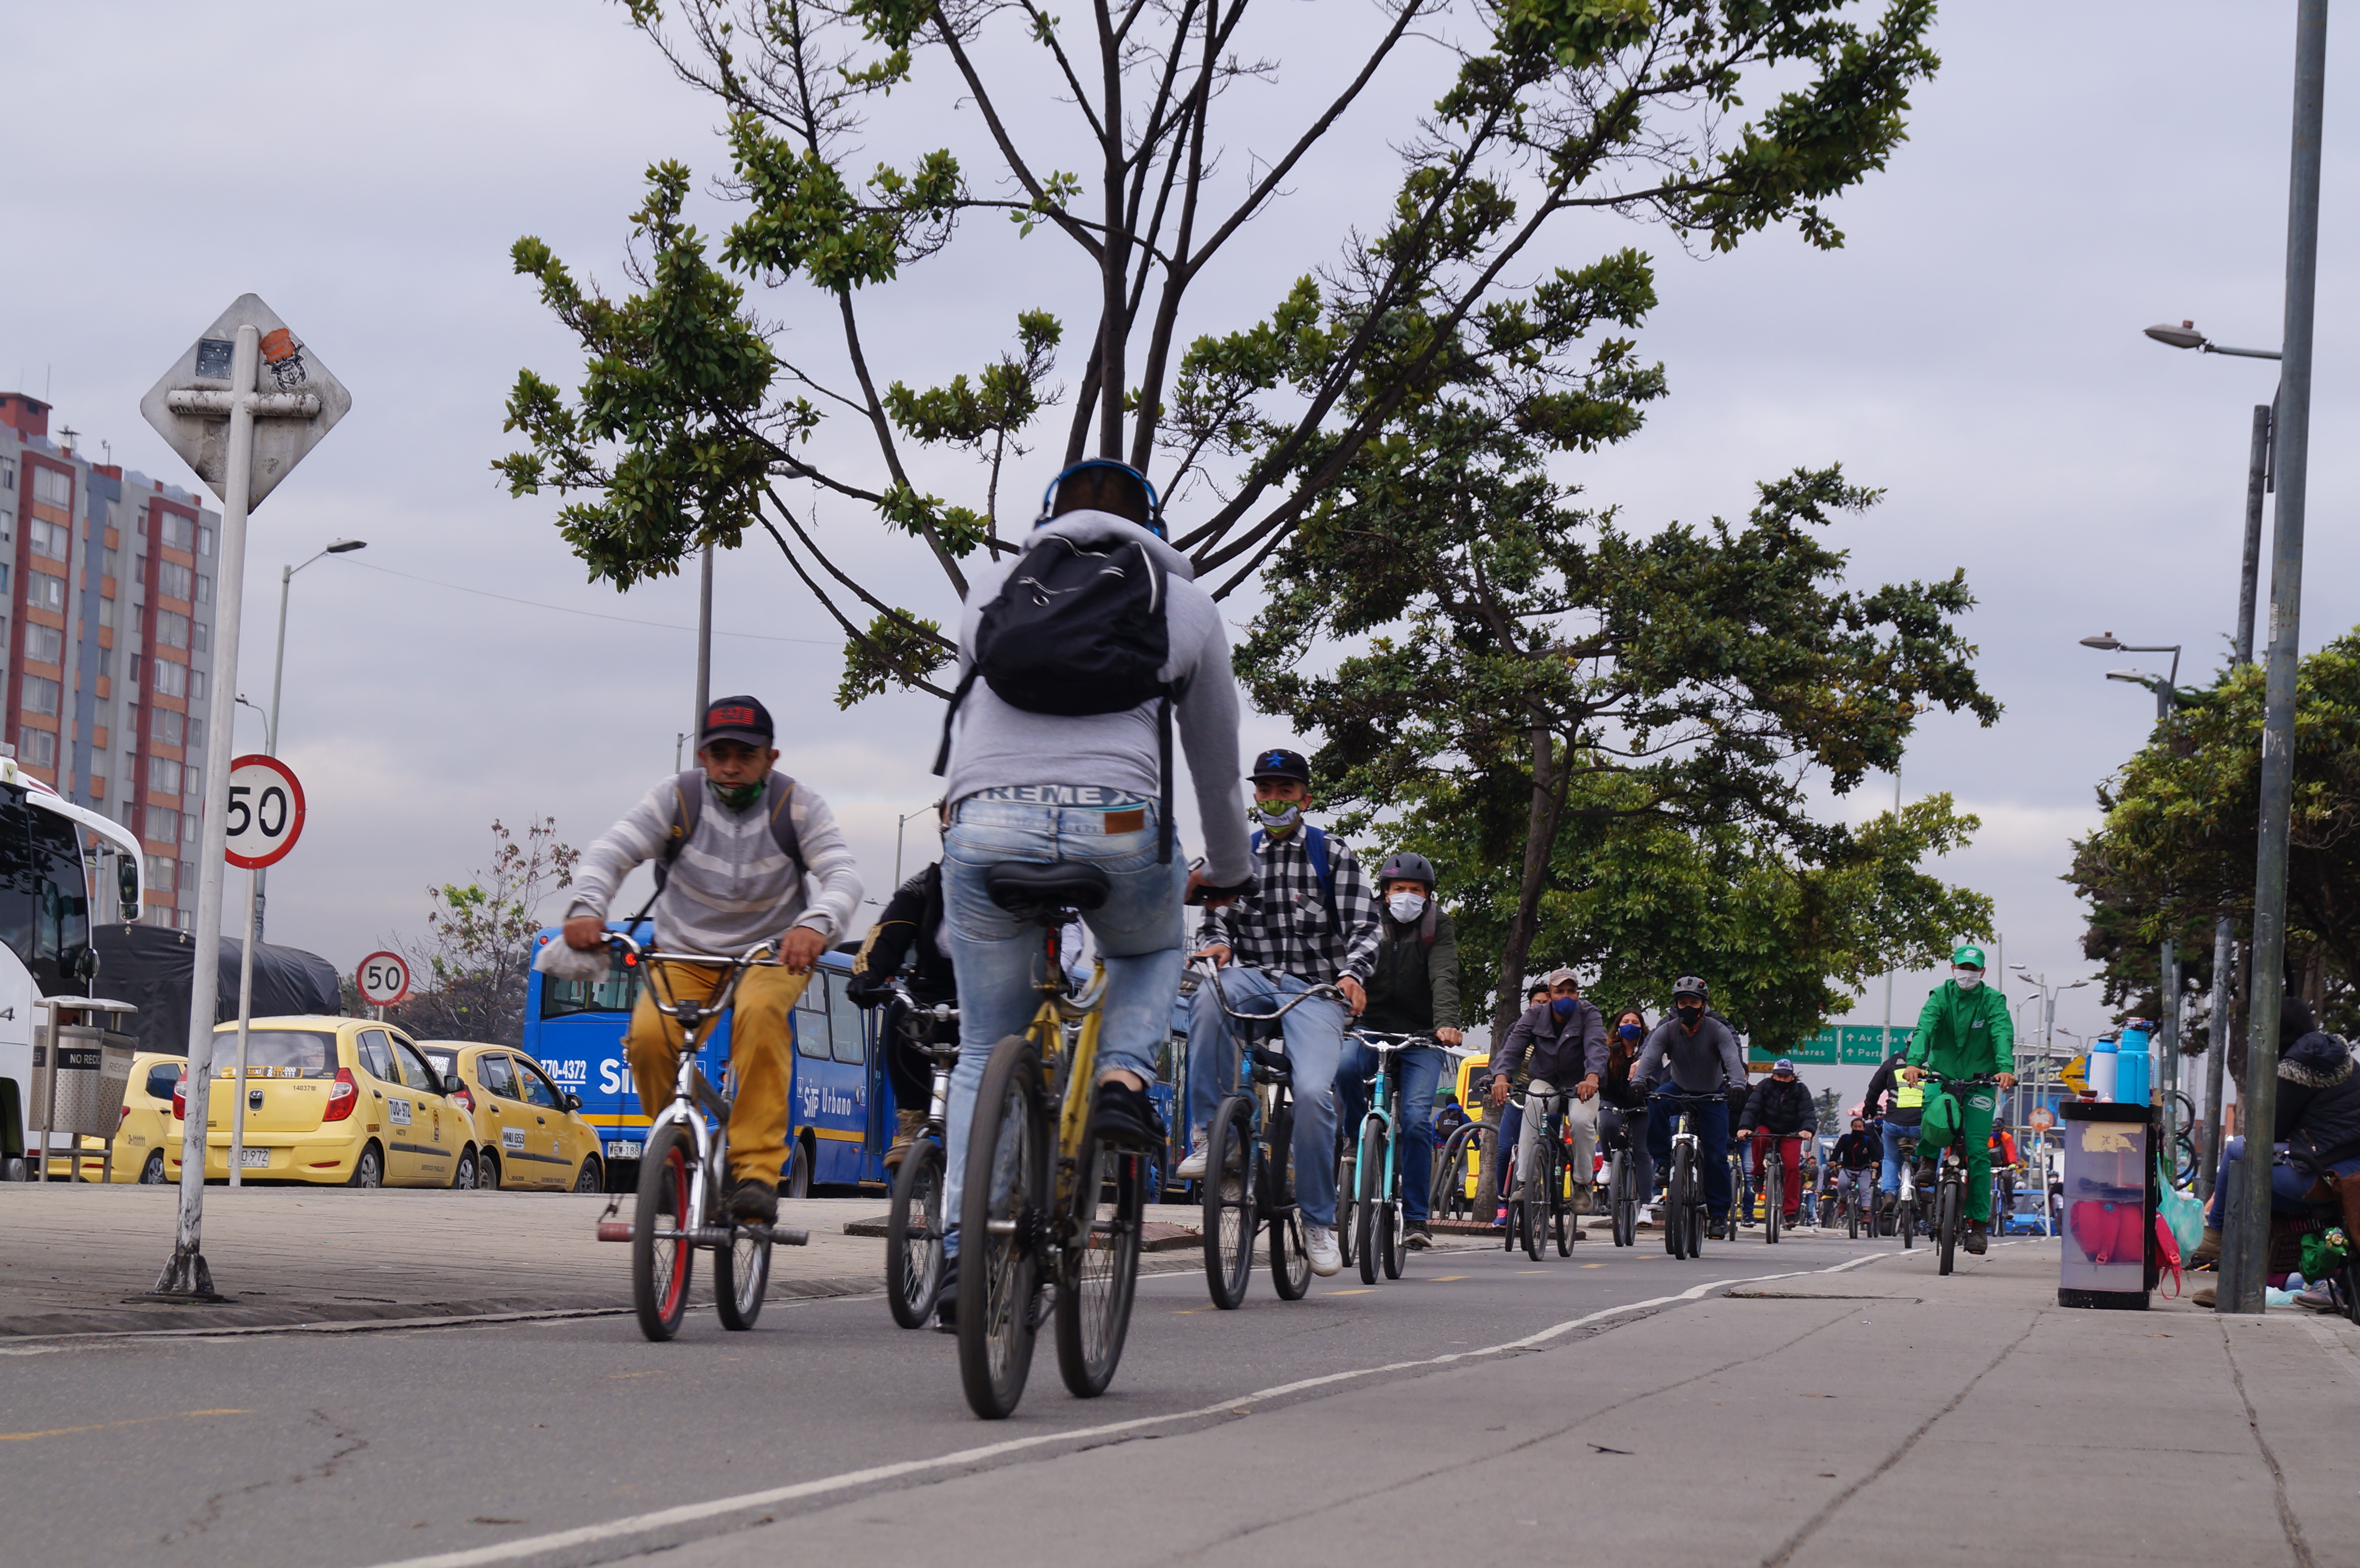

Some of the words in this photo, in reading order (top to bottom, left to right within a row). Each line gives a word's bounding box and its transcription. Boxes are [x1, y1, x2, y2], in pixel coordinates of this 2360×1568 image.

[970, 784, 1104, 805] REME
[226, 786, 287, 837] 50
[367, 966, 400, 991] 50
[1858, 1034, 1872, 1042] Av
[70, 1054, 82, 1064] NO
[1857, 1048, 1883, 1057] Porta
[541, 1059, 586, 1079] 770-4372
[822, 1087, 851, 1115] Urbano
[515, 1133, 525, 1144] 653
